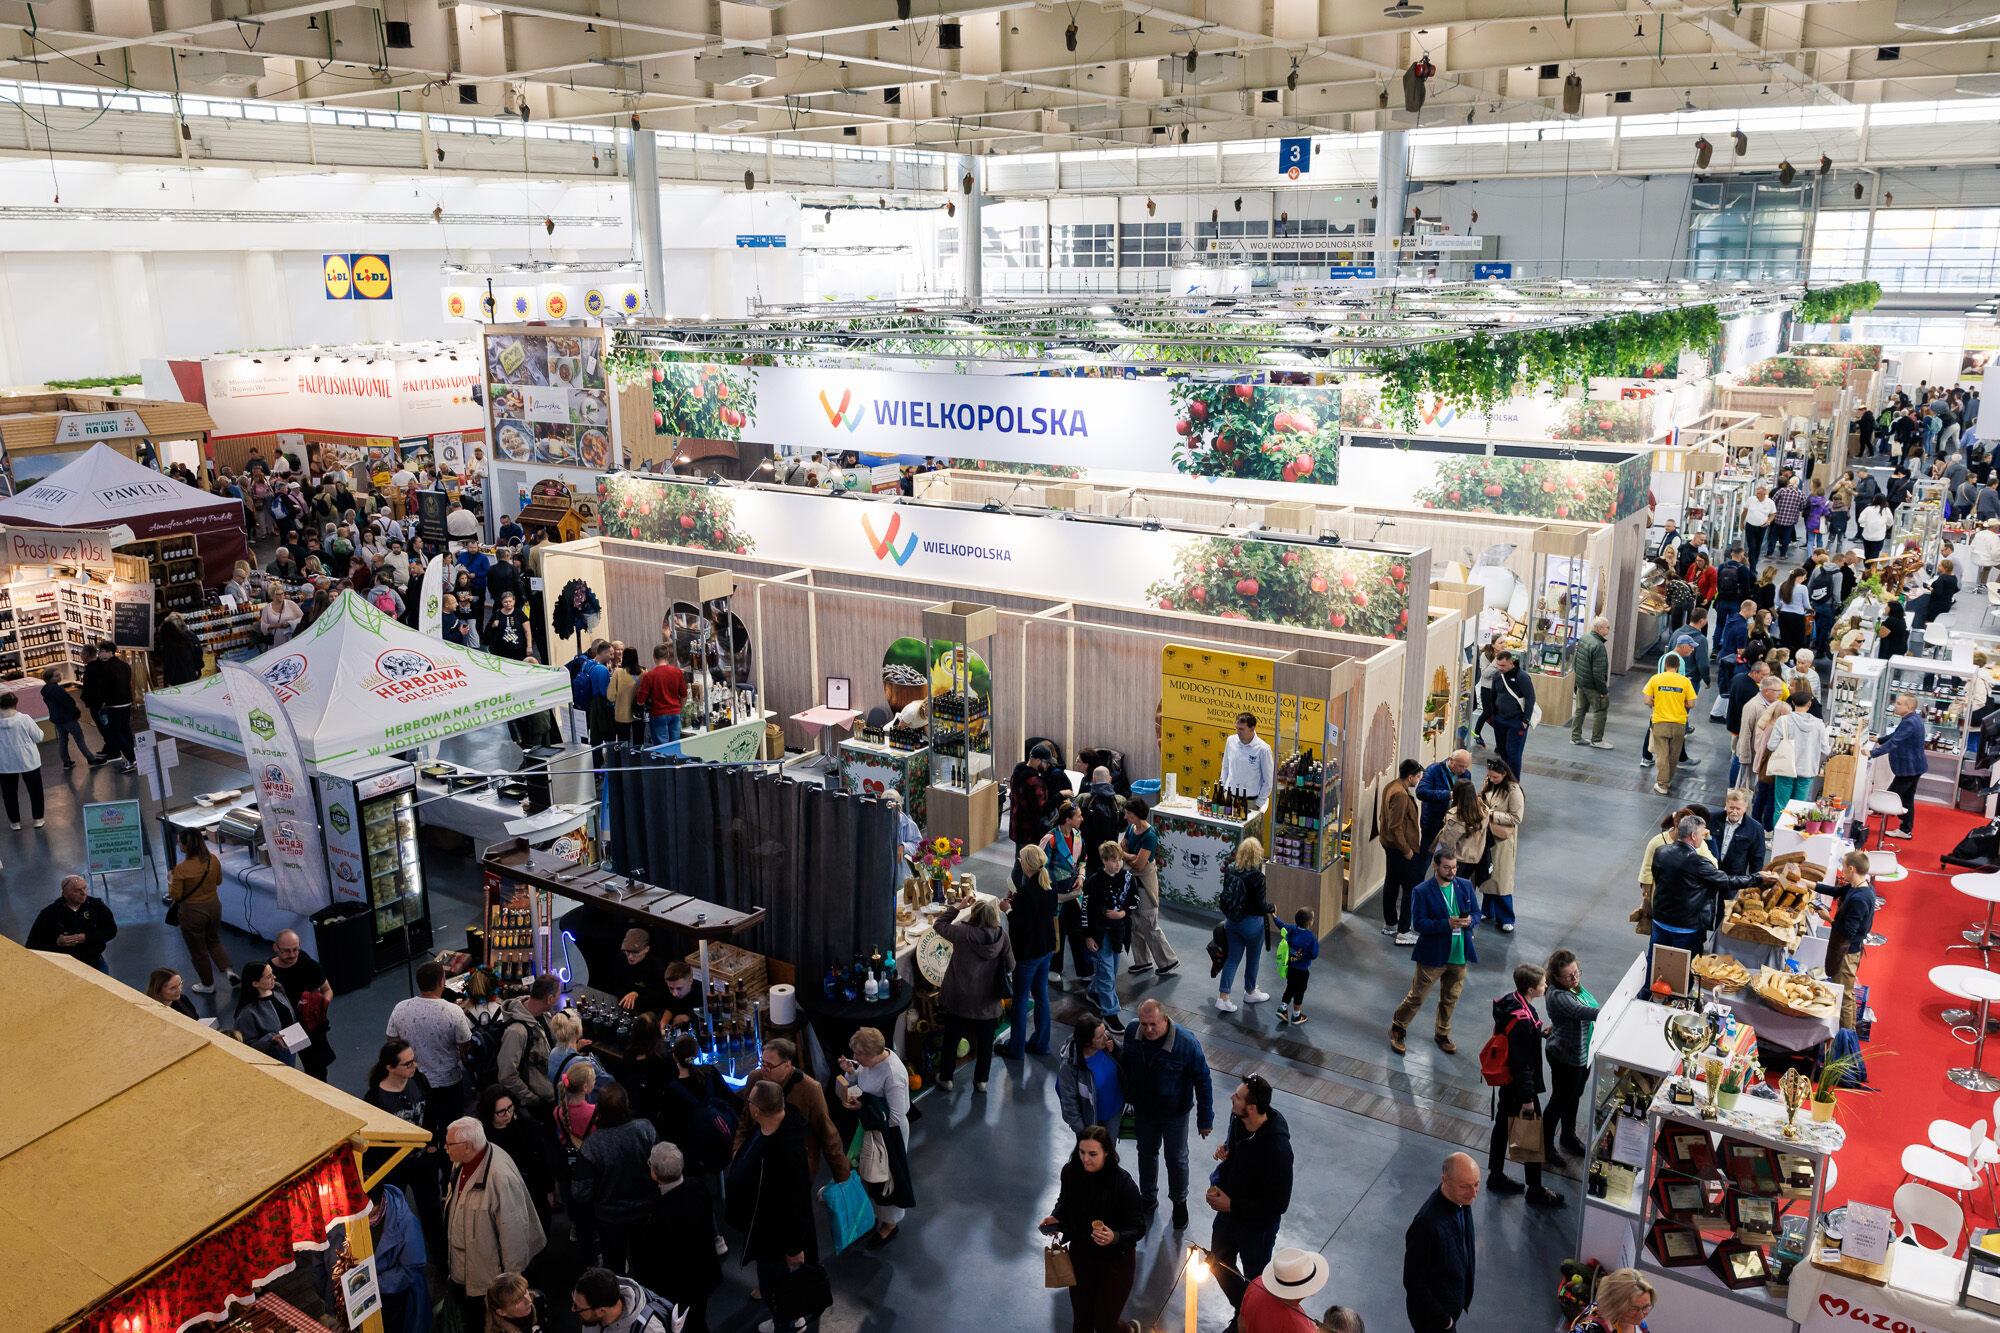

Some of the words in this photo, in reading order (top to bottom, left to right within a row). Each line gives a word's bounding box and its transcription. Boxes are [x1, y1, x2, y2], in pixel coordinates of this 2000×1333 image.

[1290, 145, 1301, 162] 3
[1250, 241, 1314, 250] WOJEWÓDZTWO
[1315, 240, 1374, 250] DOLNOŚLĄSKIE
[327, 268, 348, 282] LIDL
[356, 268, 387, 282] LIDL
[86, 426, 99, 435] NA
[101, 424, 119, 433] WSI
[874, 399, 1089, 438] WIELKOPOLSKA
[13, 534, 58, 560] Prosto
[62, 545, 77, 560] ze
[78, 537, 106, 562] Wsi
[923, 540, 1012, 561] WIELKOPOLSKA
[375, 667, 467, 699] HERBOWA
[397, 680, 468, 704] GOLCZEWO
[1170, 680, 1242, 700] MIODOSYTNIA
[1245, 692, 1321, 713] IMBIOOICZ
[1180, 693, 1240, 710] WIELKOPOLSKA
[1243, 703, 1309, 721] MANUFKTURA
[367, 746, 381, 757] W
[444, 716, 482, 736] DOMU
[492, 699, 537, 721] SZKOLE
[385, 712, 451, 738] HERBOWA
[453, 705, 471, 718] NA
[1081, 894, 1089, 927] YOUTH
[920, 931, 940, 959] ZAGRODA
[1818, 1293, 1927, 1333] Mazo
